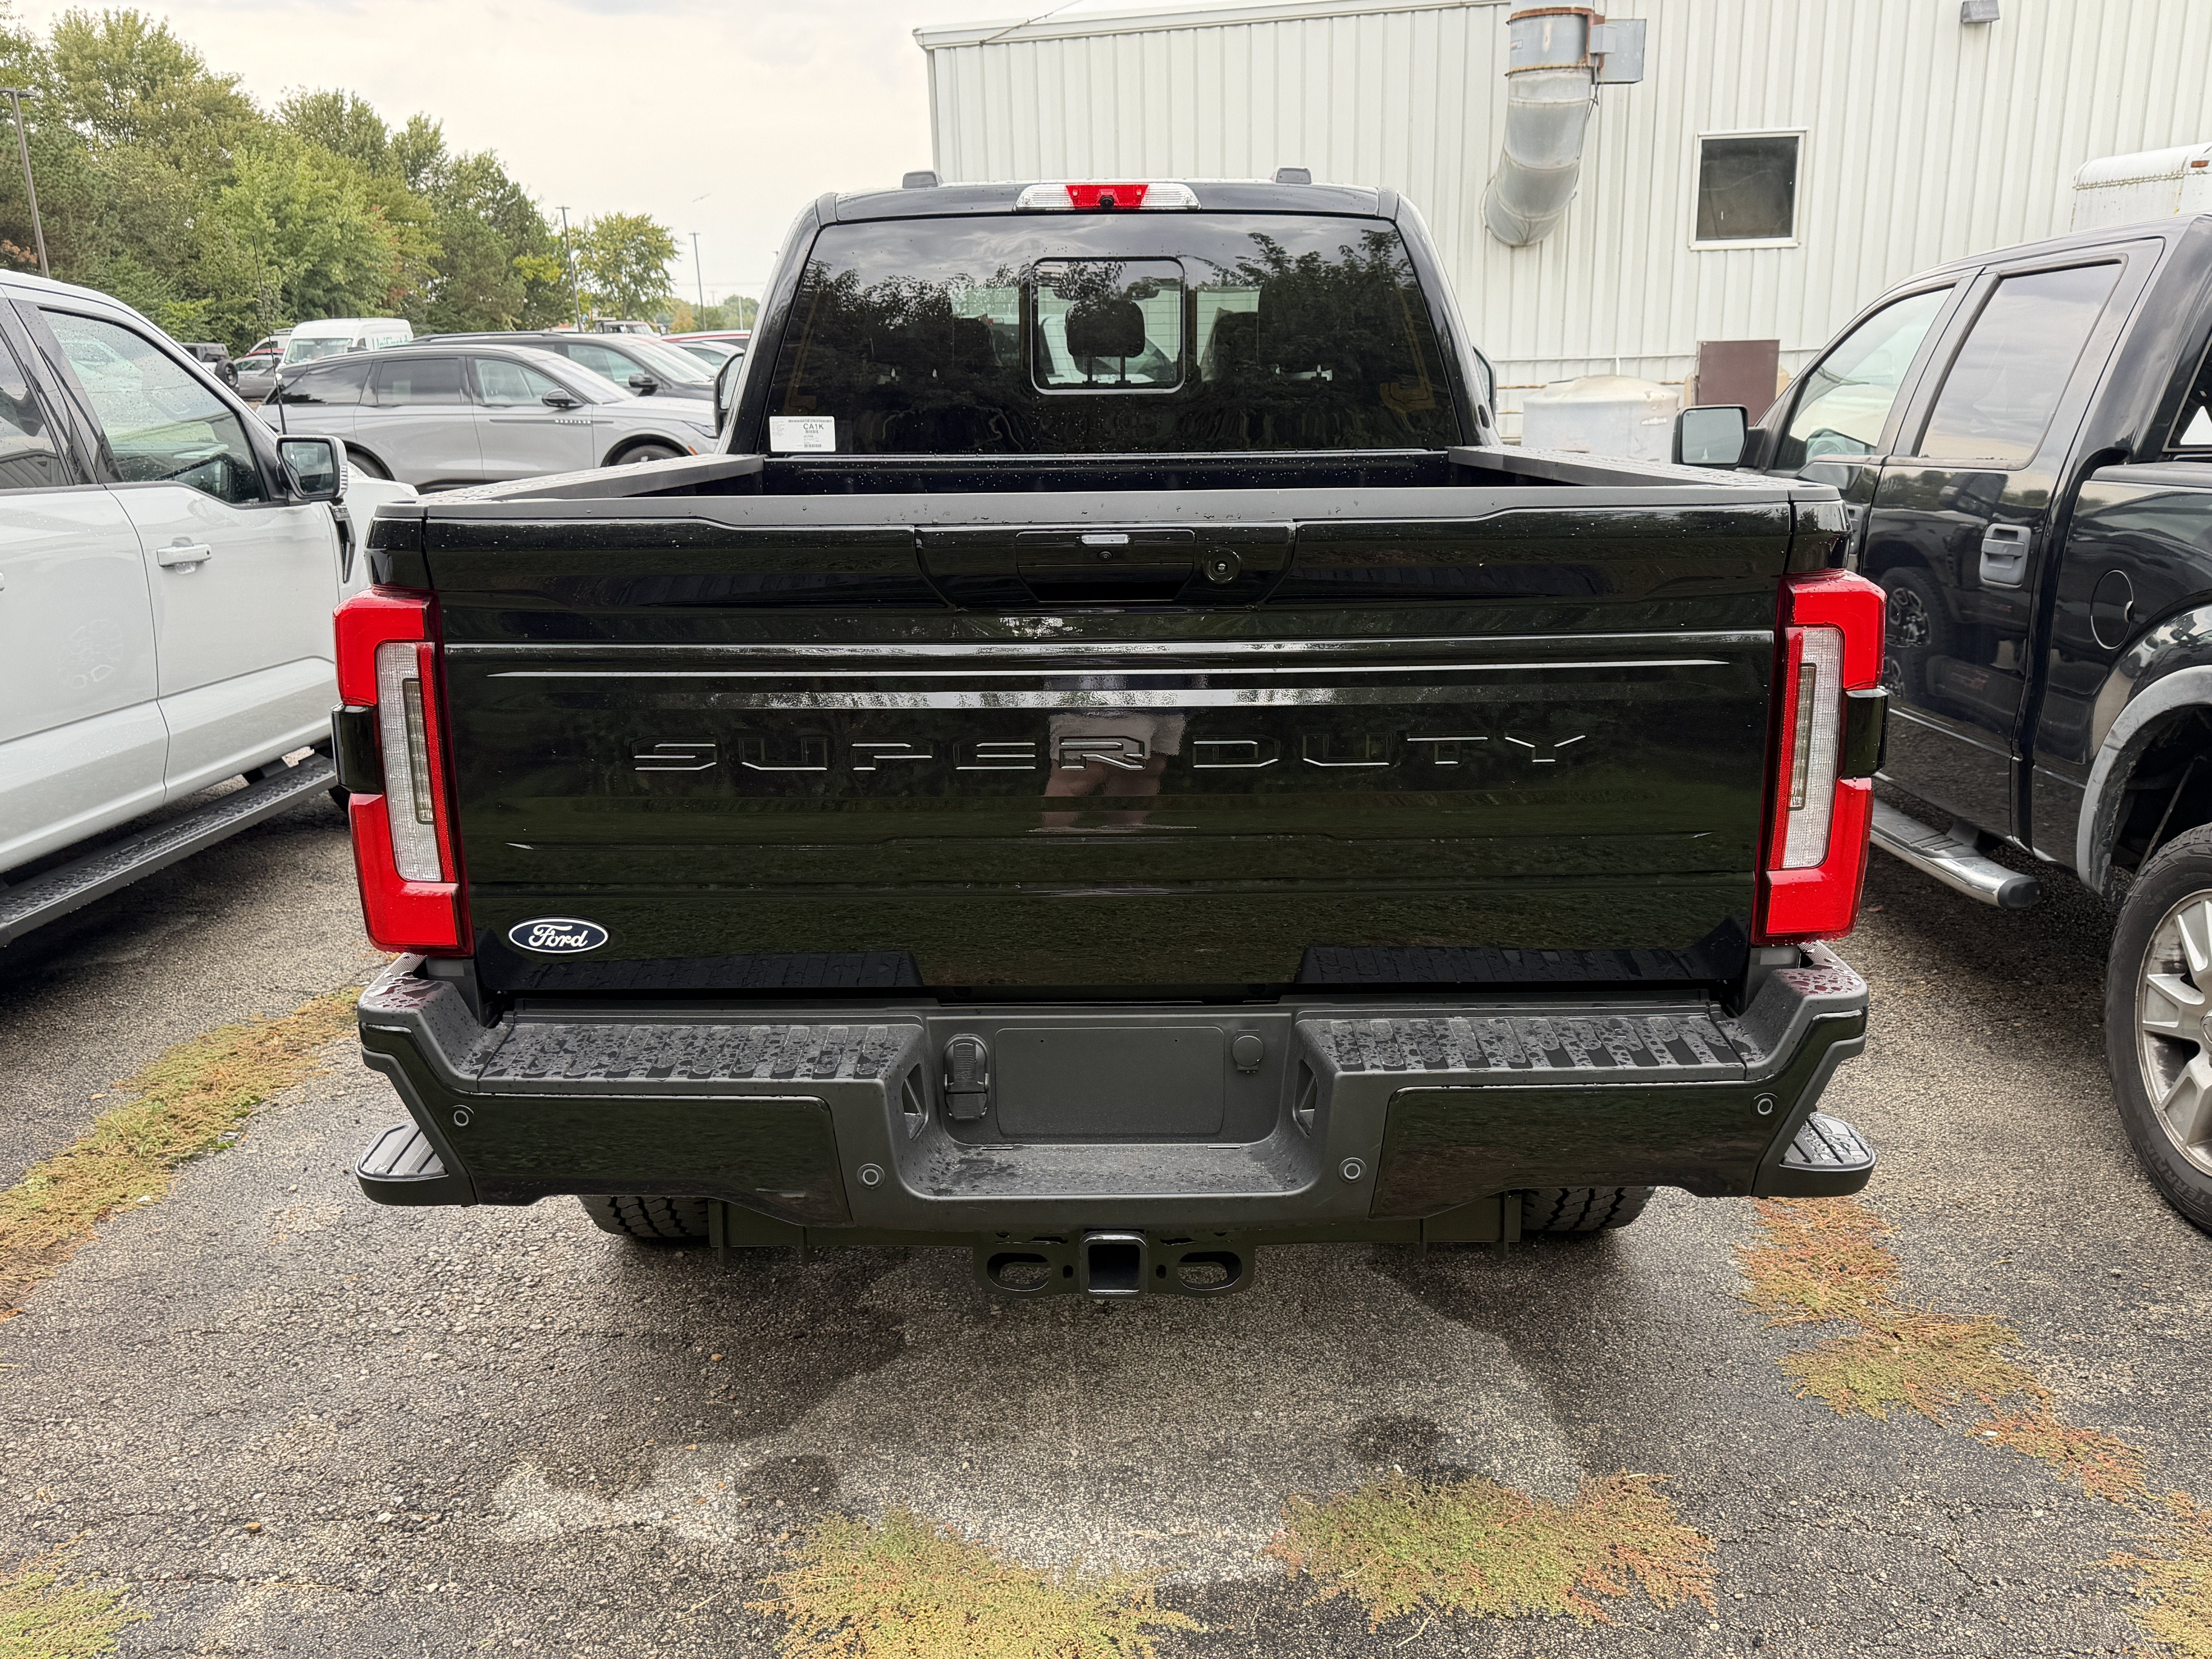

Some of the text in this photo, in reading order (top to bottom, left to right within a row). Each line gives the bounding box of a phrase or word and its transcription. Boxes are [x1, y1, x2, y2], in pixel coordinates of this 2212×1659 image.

[631, 731, 1586, 770] SUPER DUTY
[529, 924, 588, 947] Ford
